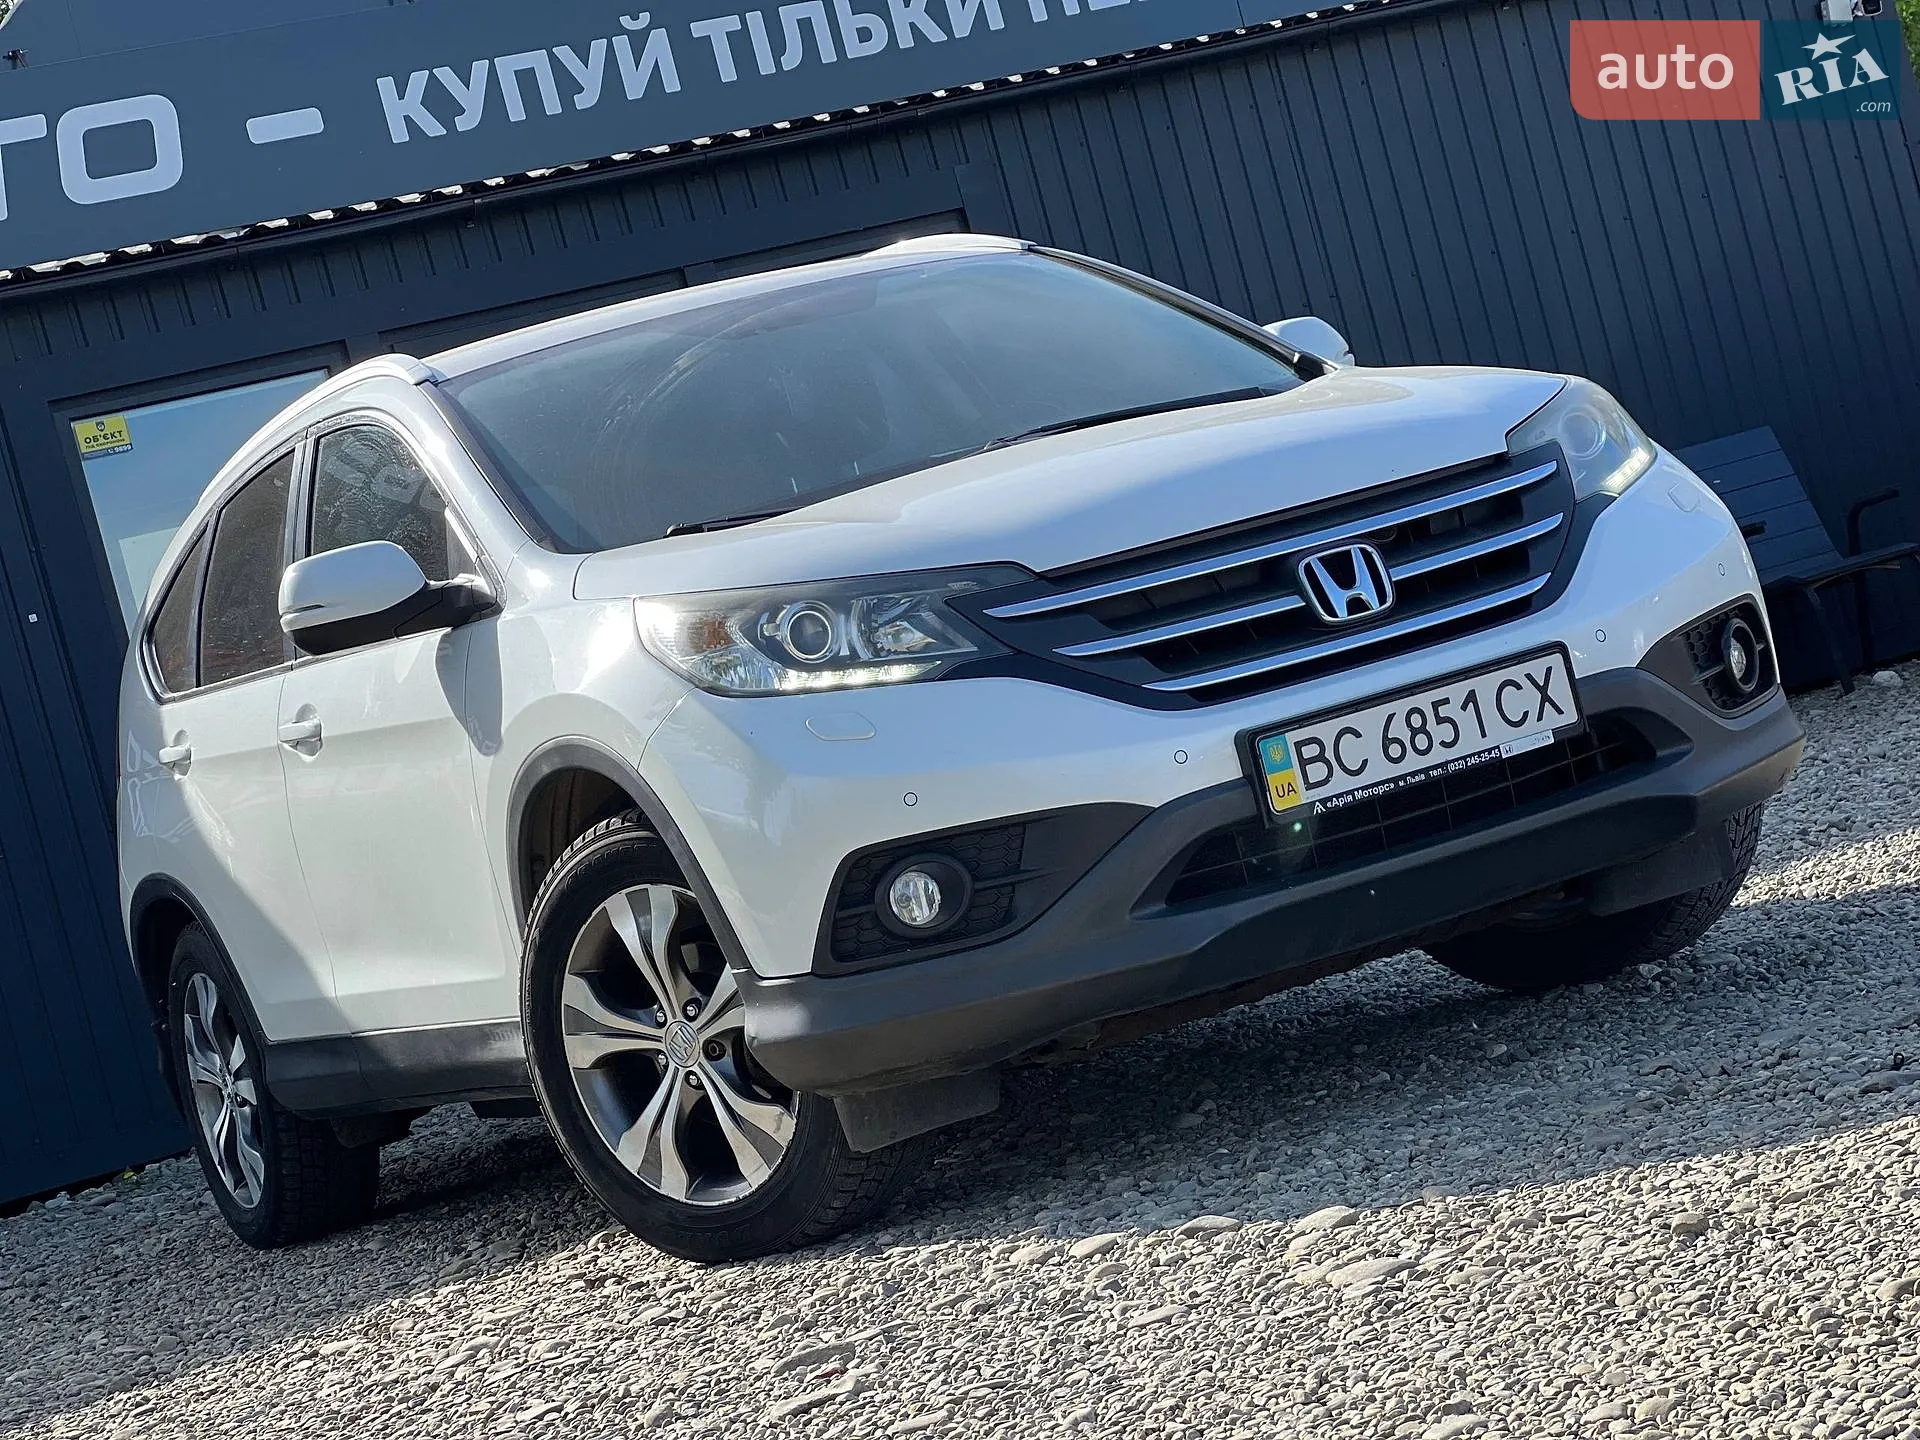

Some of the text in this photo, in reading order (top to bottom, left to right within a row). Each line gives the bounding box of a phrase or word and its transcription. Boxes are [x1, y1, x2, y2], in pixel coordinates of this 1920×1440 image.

[377, 12, 681, 143] КУПУЙ
[692, 0, 1005, 83] ТІЛЬКИ
[84, 430, 123, 444] ОБ'ЄКТ
[1294, 665, 1566, 791] BC 6851 CX
[1447, 761, 1466, 773] (032)
[1466, 748, 1501, 766] 245-25-45
[1275, 782, 1297, 799] UA
